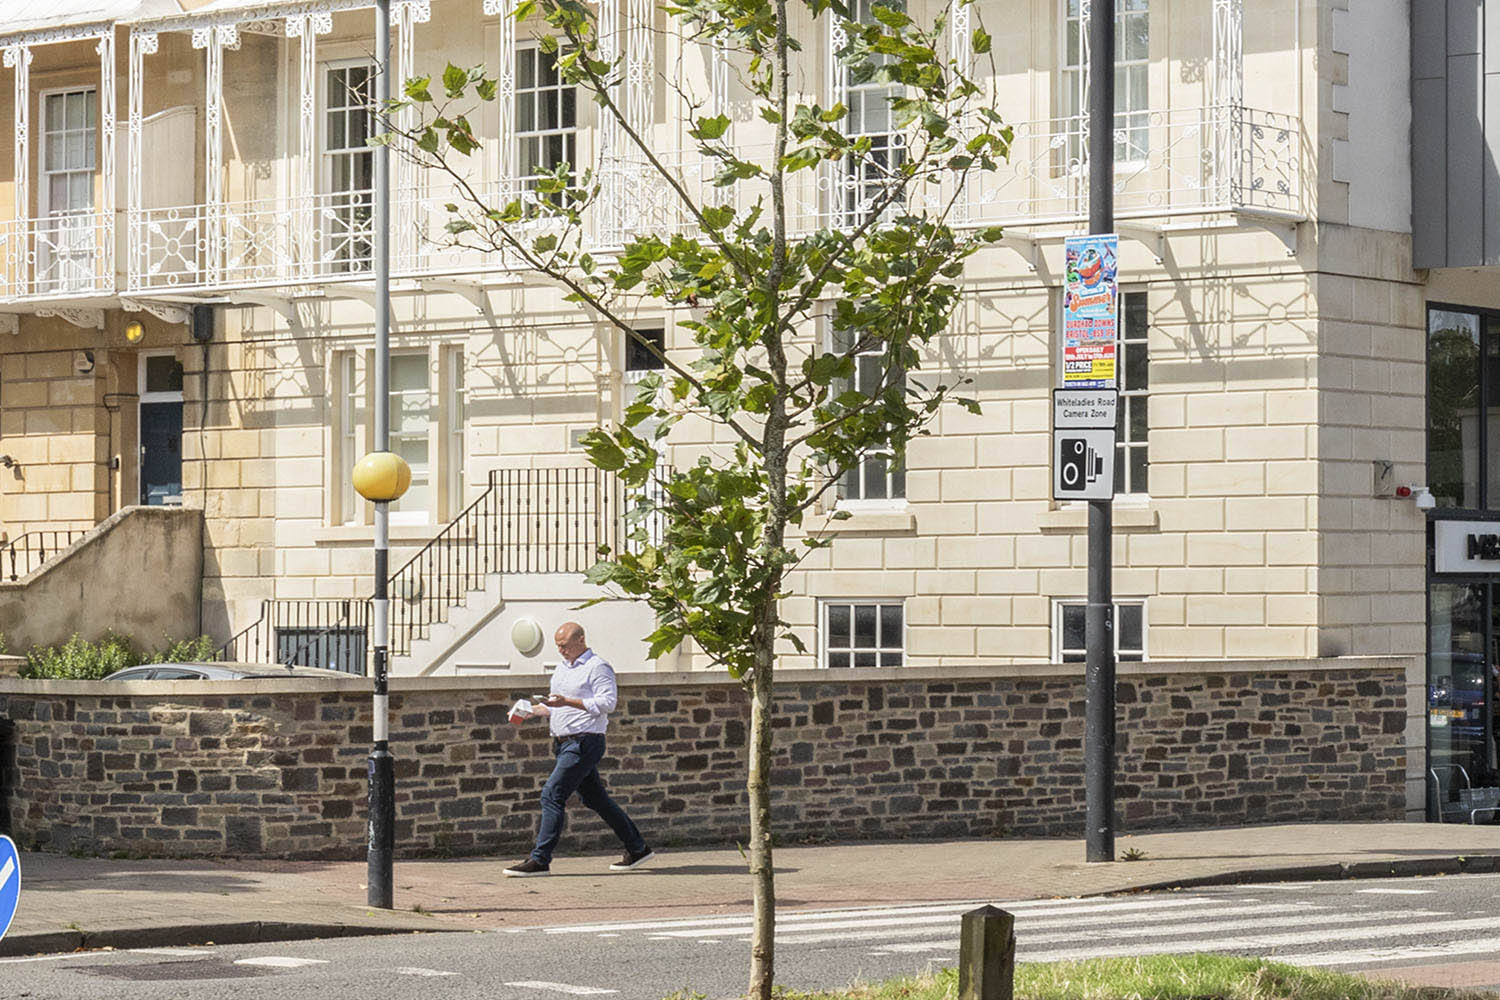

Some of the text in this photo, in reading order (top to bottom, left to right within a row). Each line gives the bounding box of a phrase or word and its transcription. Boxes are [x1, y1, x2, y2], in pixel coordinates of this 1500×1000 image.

[1057, 398, 1115, 407] Whiteladies Road
[1063, 409, 1107, 418] Camera Zone
